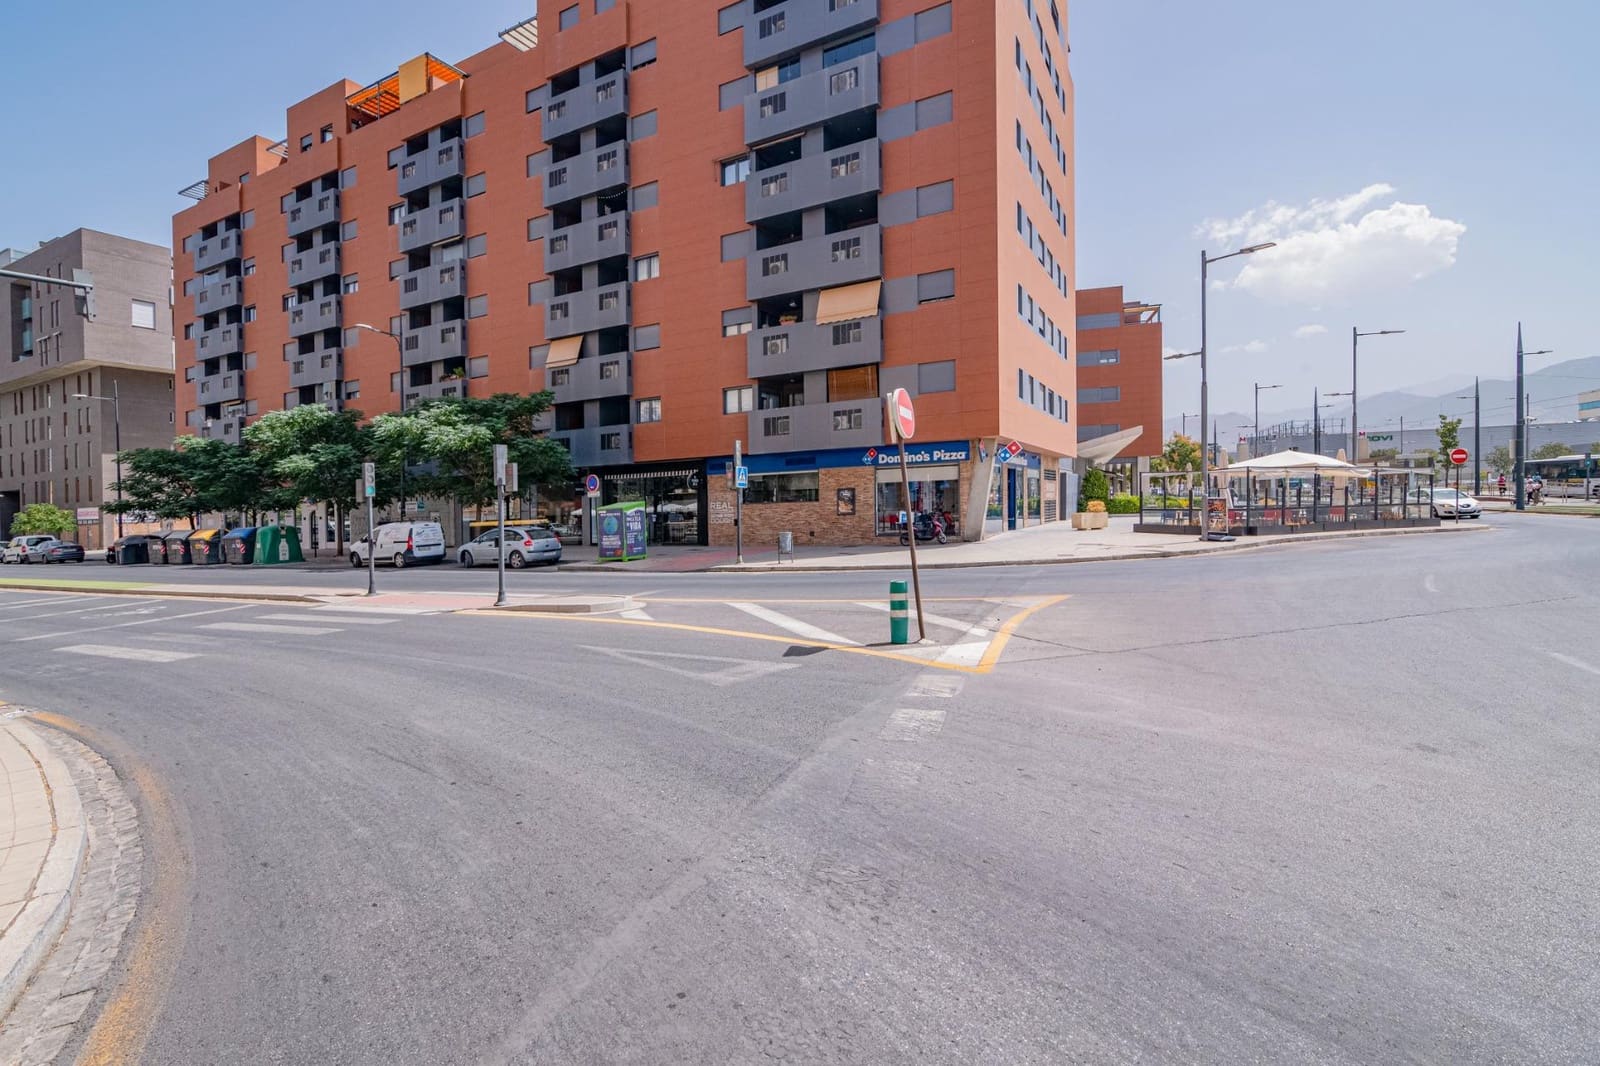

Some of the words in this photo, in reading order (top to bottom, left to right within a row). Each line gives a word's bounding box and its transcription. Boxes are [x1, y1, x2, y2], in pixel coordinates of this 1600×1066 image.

[878, 451, 930, 464] Domino's
[933, 449, 967, 461] Pizza
[711, 501, 733, 510] REAL
